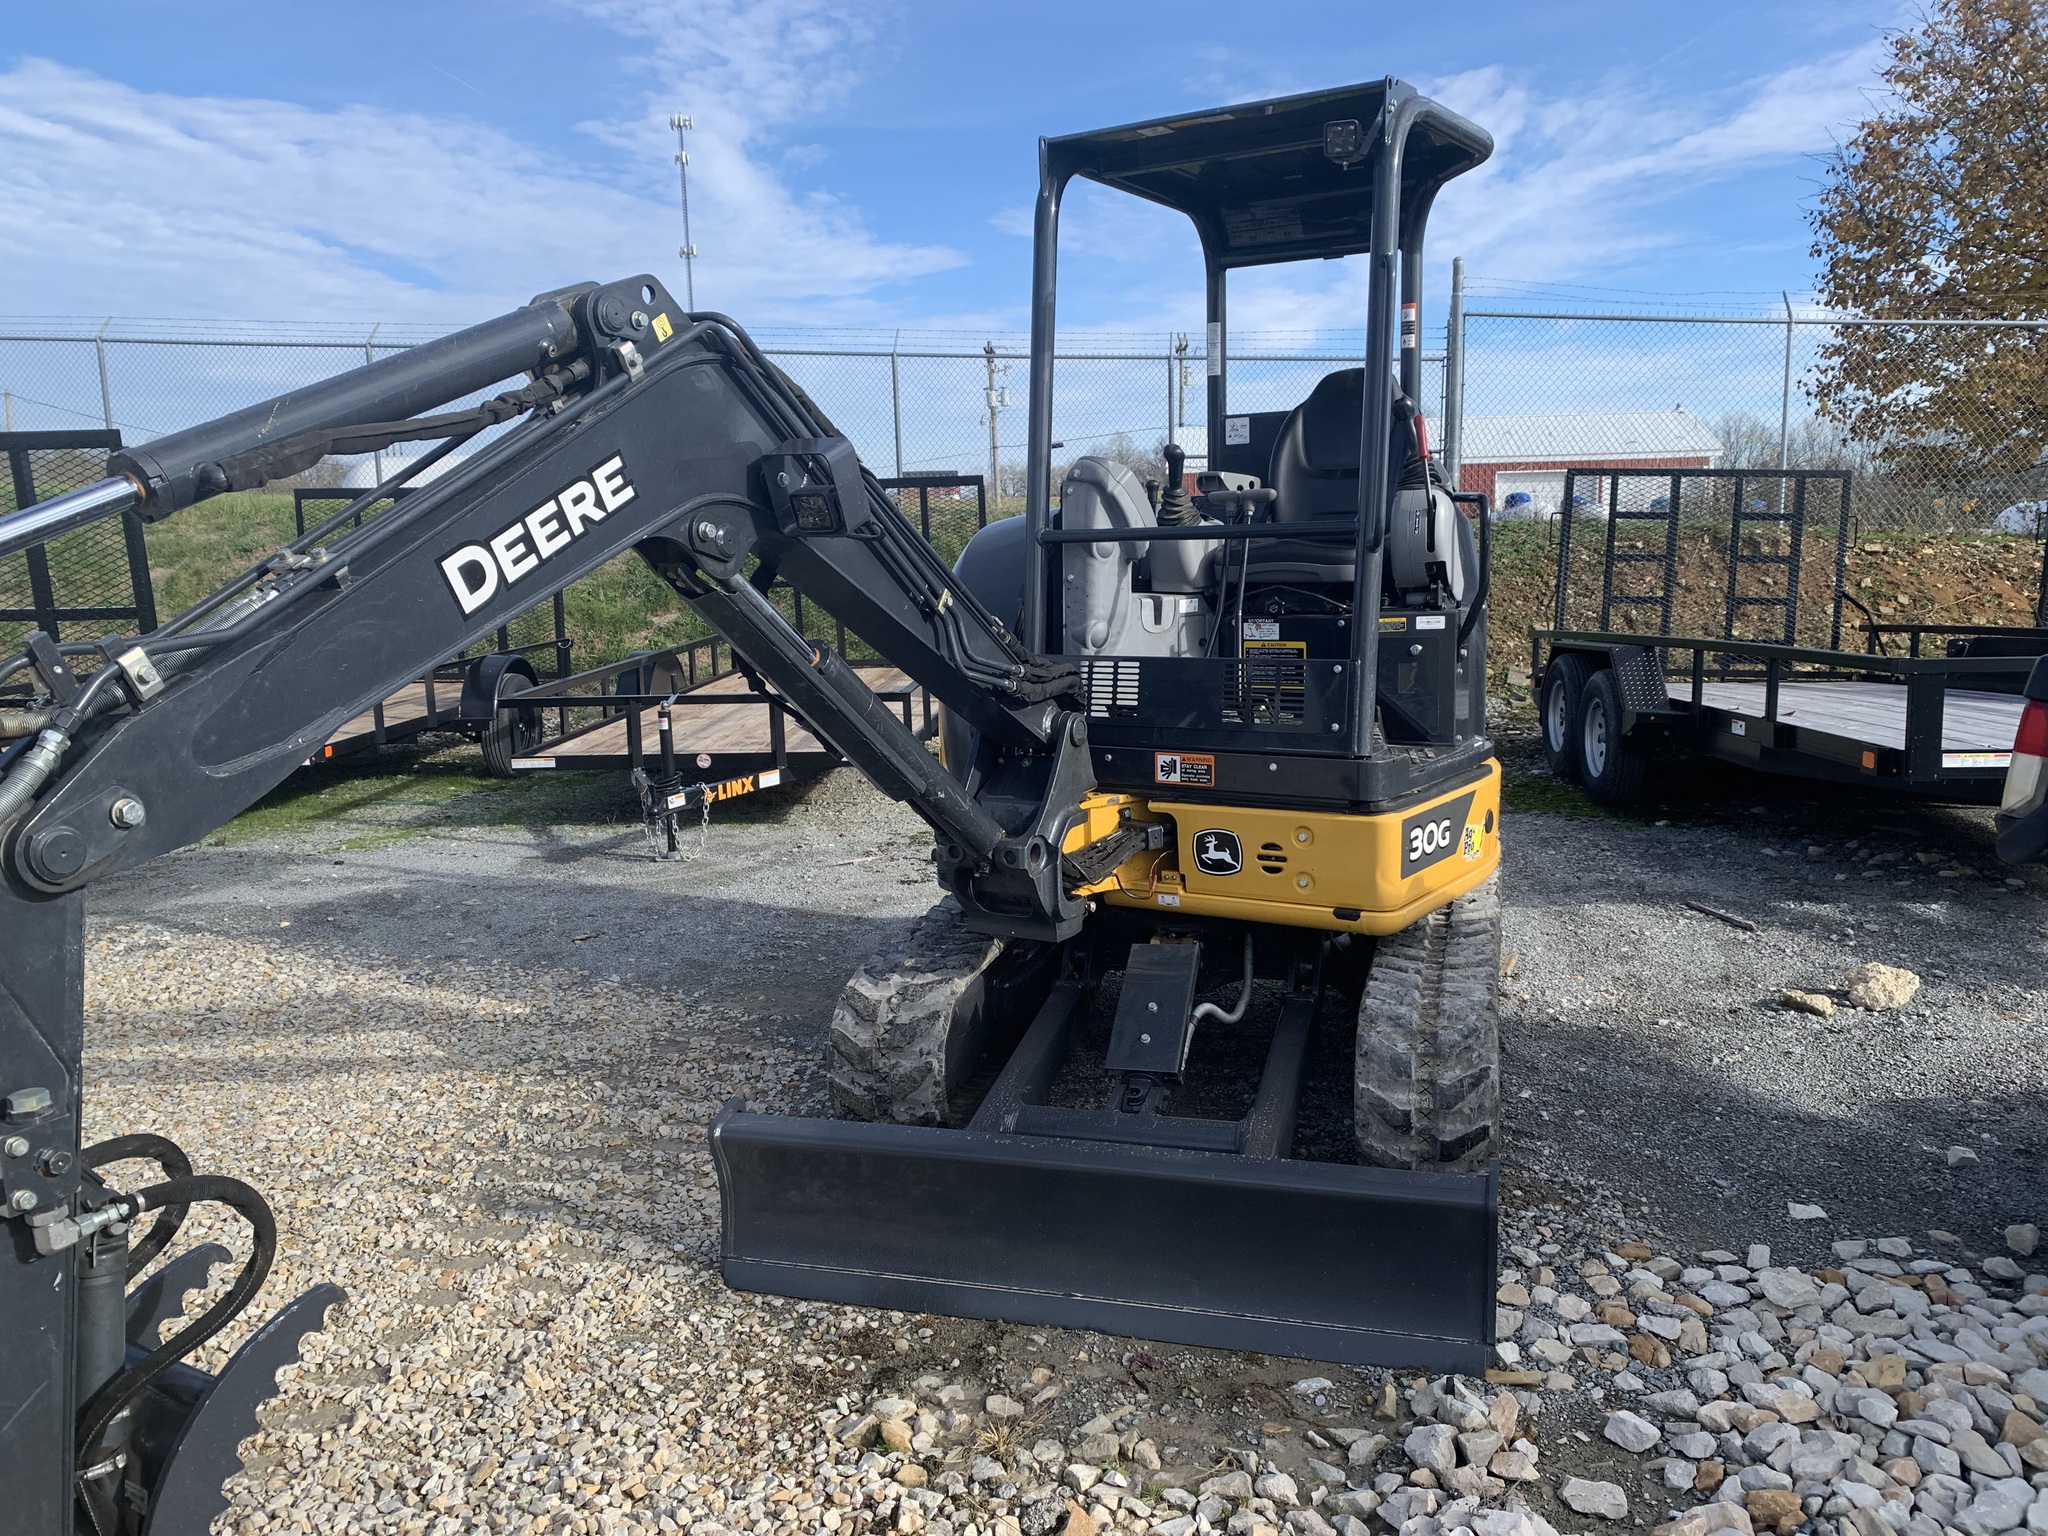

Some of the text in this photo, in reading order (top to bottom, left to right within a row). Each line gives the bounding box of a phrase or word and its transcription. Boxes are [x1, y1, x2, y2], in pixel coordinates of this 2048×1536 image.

[441, 455, 635, 615] DEERE
[717, 775, 755, 801] LINX
[1409, 818, 1451, 862] 30G
